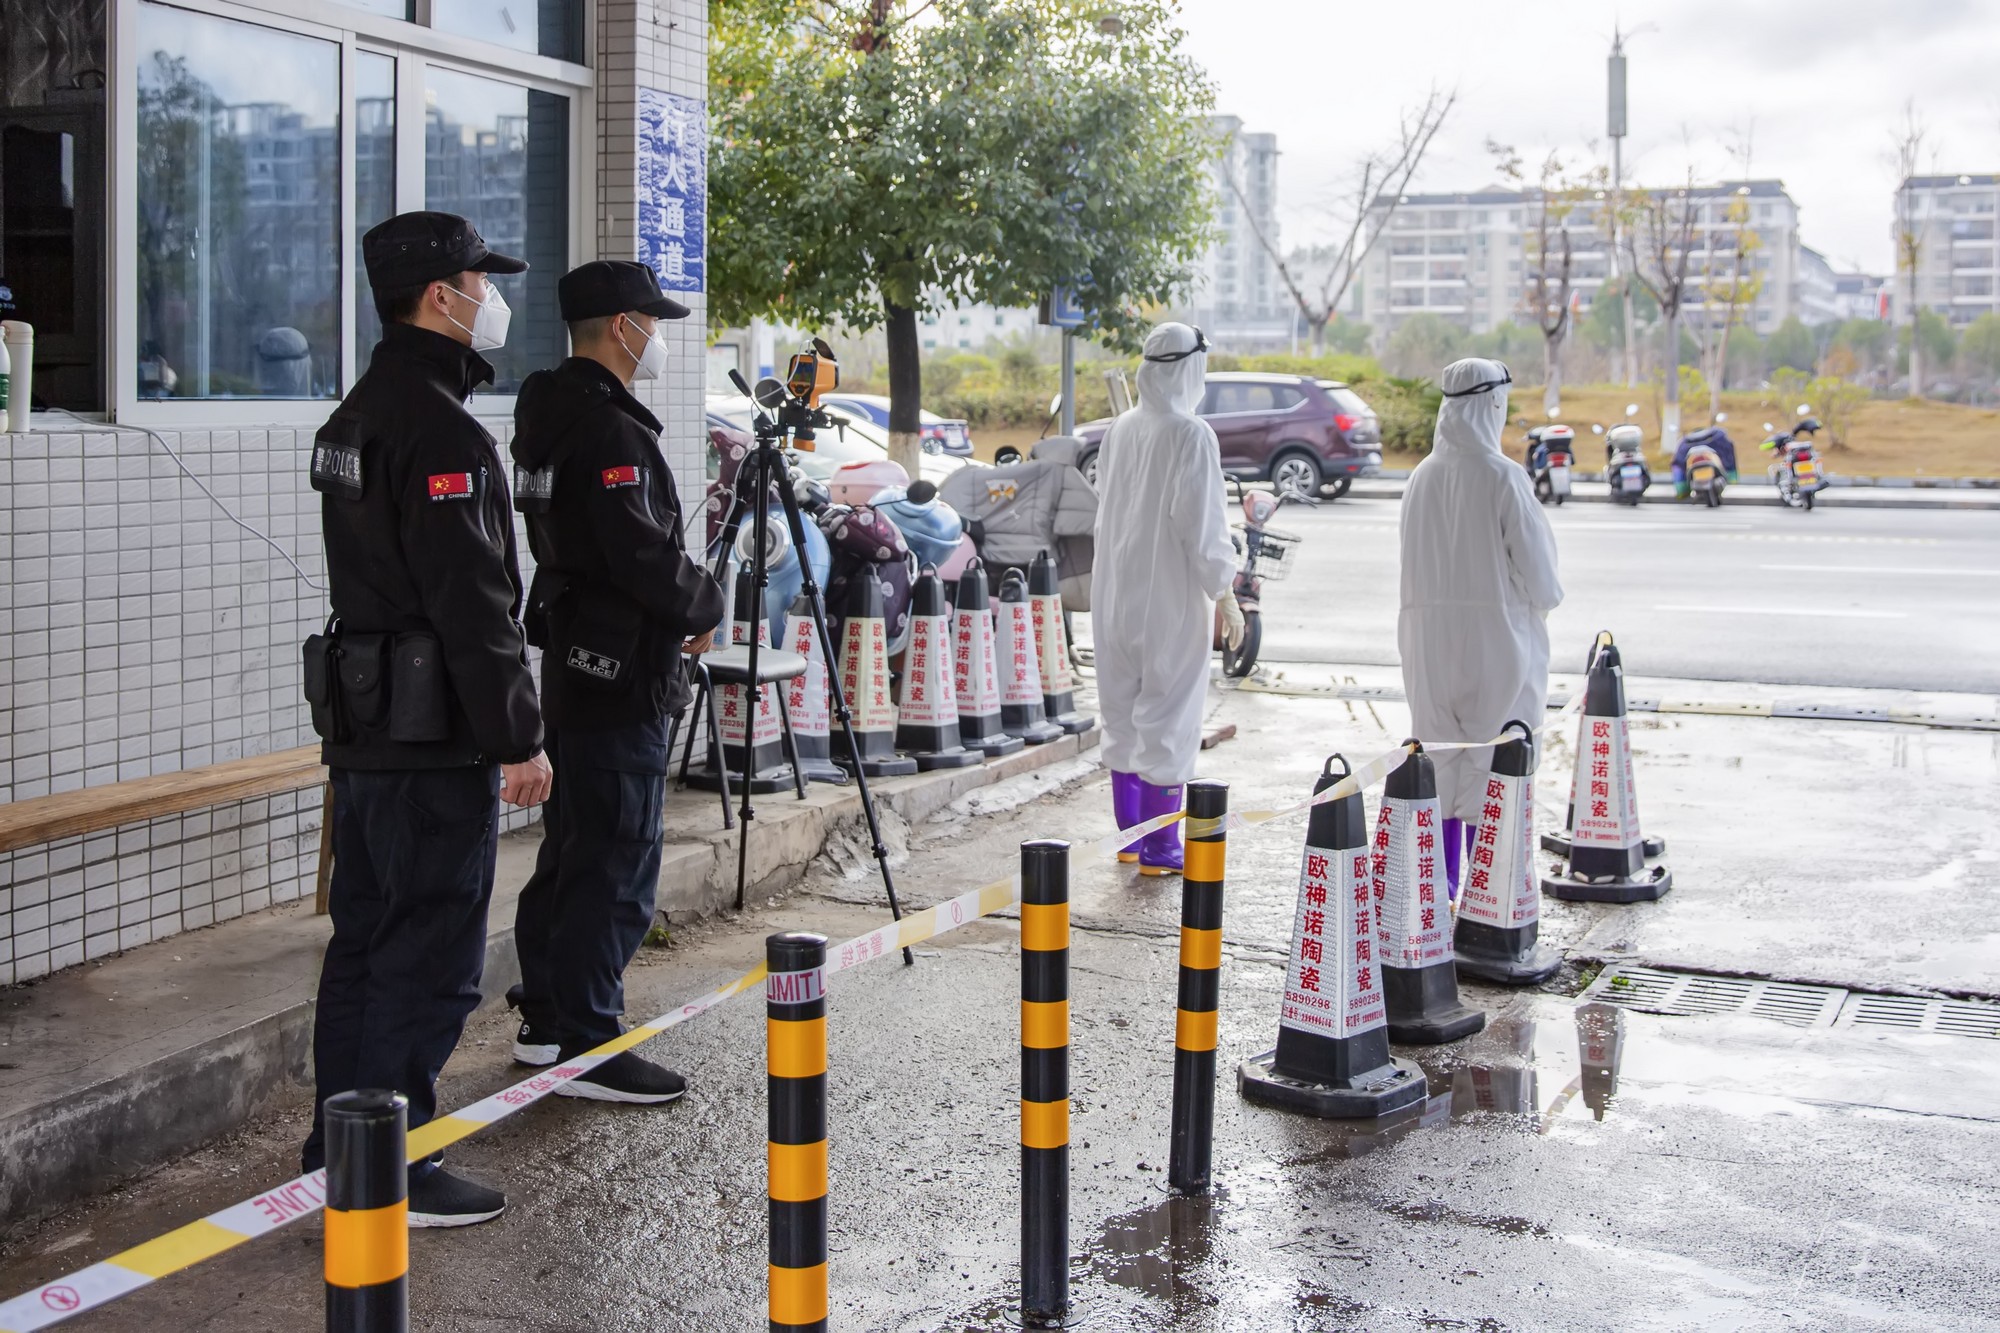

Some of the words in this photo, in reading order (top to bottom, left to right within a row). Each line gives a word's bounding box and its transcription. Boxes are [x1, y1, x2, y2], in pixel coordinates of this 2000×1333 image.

[656, 104, 687, 281] 行人通道
[570, 657, 613, 677] POLICE
[789, 621, 813, 708] 欧神陶瓷
[873, 623, 884, 706] 欧神诺陶瓷
[911, 620, 928, 701] 欧神诺陶瓷
[955, 614, 972, 692] 欧神诺陶瓷
[1013, 607, 1026, 682] 欧神诺陶瓷
[1591, 721, 1610, 818] 欧神诺陶瓷
[1417, 806, 1434, 931] 欧神诺陶瓷
[1471, 779, 1505, 891] 欧神诺陶瓷
[1299, 854, 1329, 993] 欧神诺陶瓷
[1353, 854, 1372, 992] 欧神诺陶瓷
[1285, 991, 1331, 1010] 5890298
[1349, 992, 1381, 1010] 5890298
[495, 1066, 585, 1105] 警戒线
[252, 1182, 322, 1223] LINE
